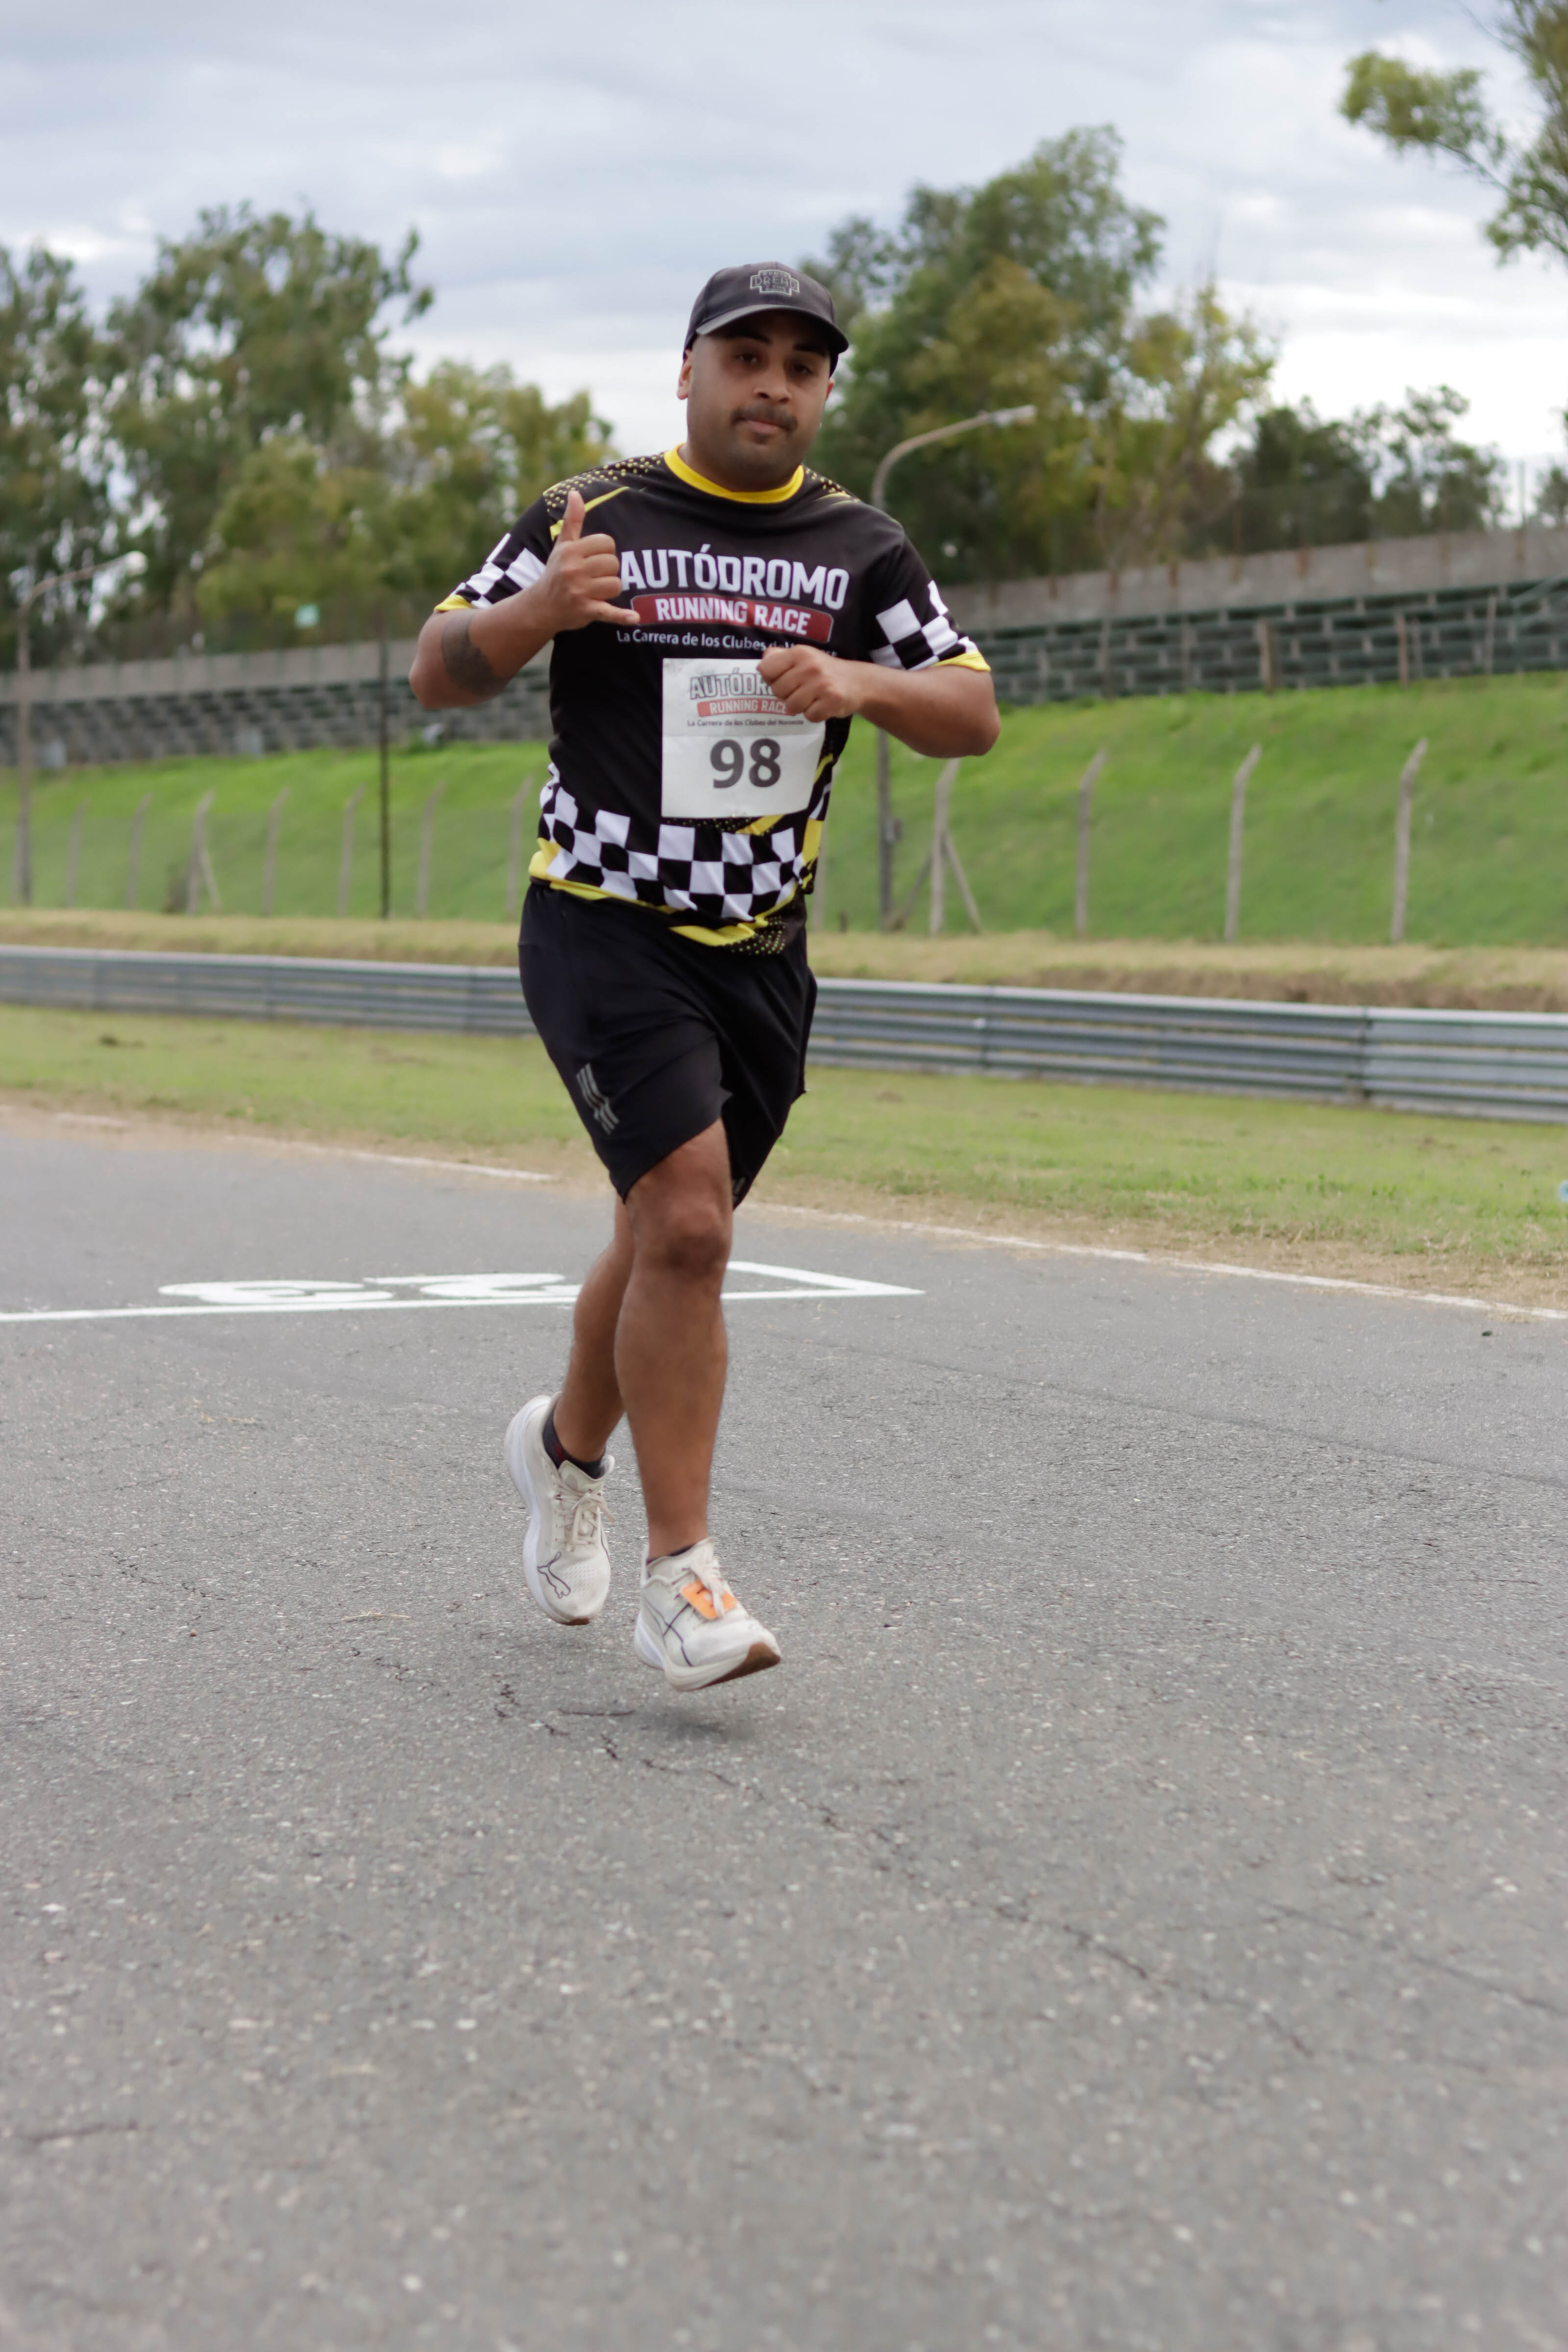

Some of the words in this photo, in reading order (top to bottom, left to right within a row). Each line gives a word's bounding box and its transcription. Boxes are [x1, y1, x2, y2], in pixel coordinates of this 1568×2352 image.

[620, 544, 850, 611] AUTÓDROMO
[655, 597, 747, 623] RUNNING
[754, 604, 811, 636] RACE
[616, 630, 630, 642] La
[633, 630, 679, 644] Carrera
[682, 632, 699, 646] de
[701, 634, 720, 648] los
[722, 636, 767, 650] Clubes
[690, 667, 773, 700] AUTÓDR
[710, 700, 759, 714] RUNNING
[710, 738, 781, 788] 98
